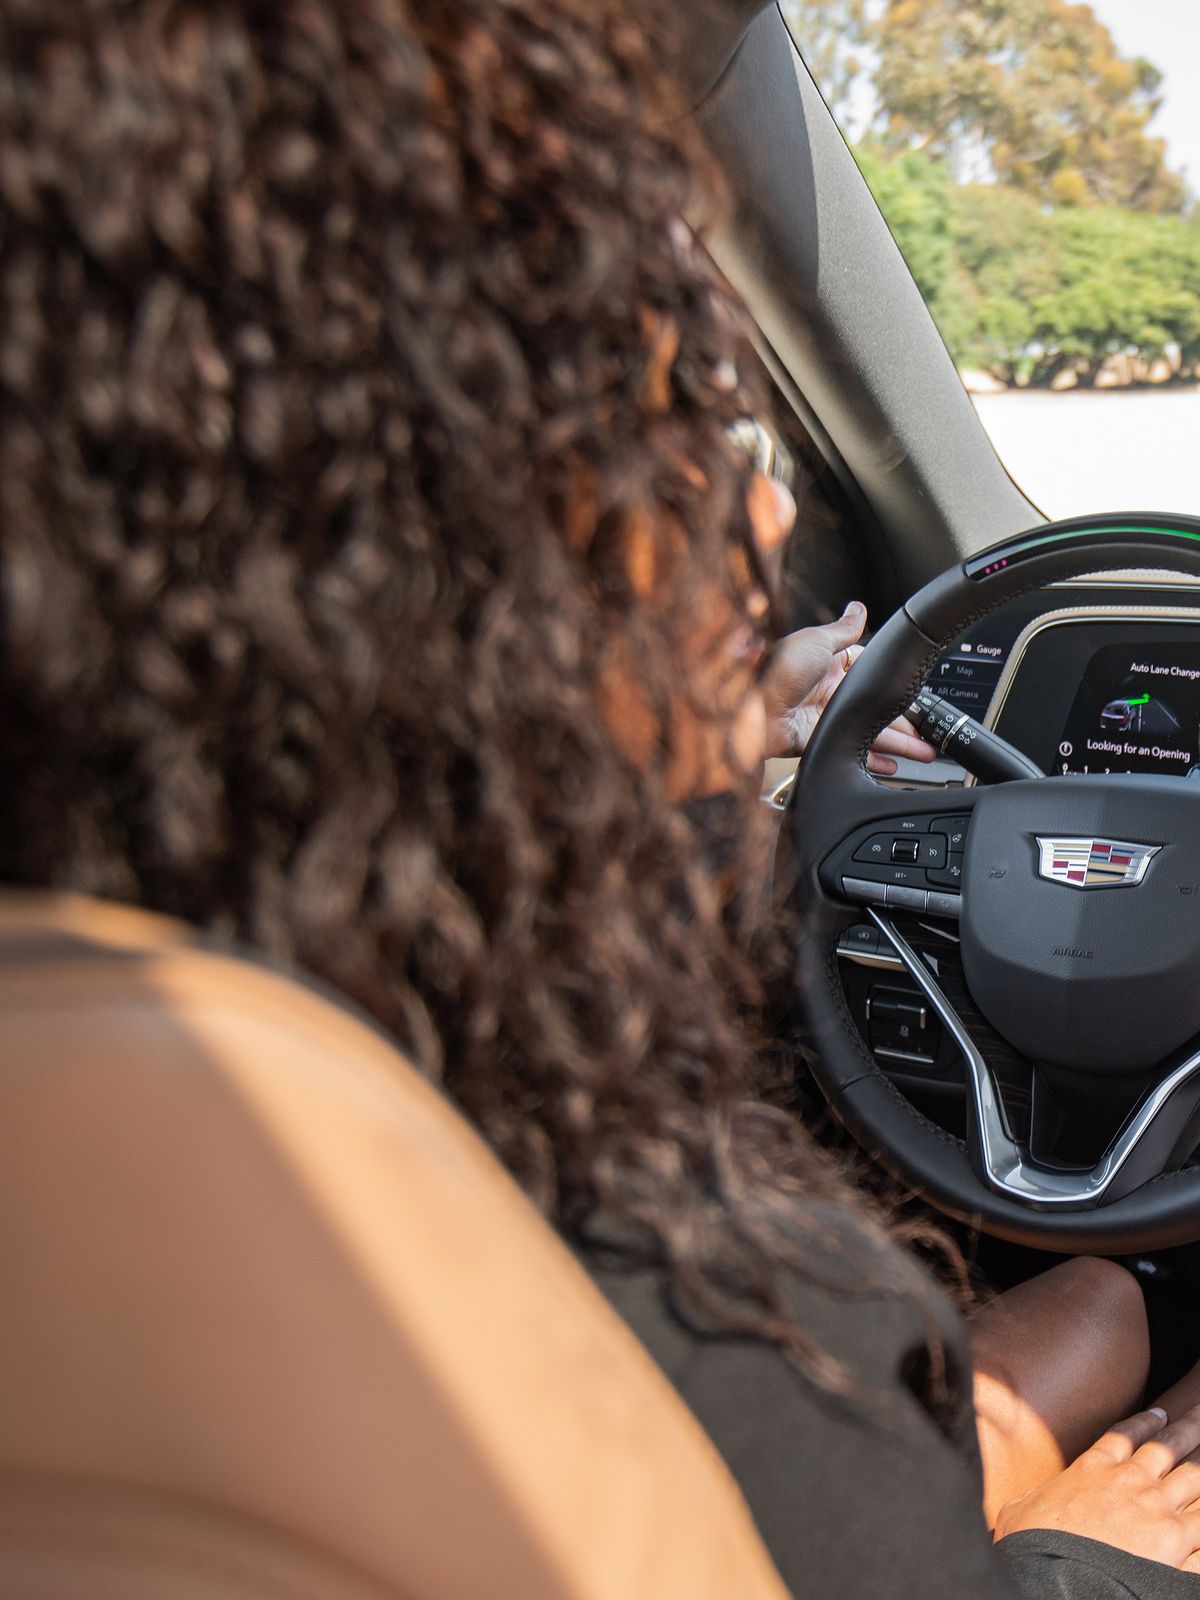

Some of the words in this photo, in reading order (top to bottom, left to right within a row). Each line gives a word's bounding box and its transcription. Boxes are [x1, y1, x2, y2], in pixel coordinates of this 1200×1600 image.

[977, 644, 1002, 656] Gauge
[956, 666, 974, 677] Map
[1131, 662, 1150, 674] Auto
[1150, 664, 1170, 675] Lane
[1170, 667, 1200, 680] Change
[950, 688, 978, 699] Camera
[1087, 738, 1122, 755] Looking
[1124, 742, 1138, 754] for
[1138, 746, 1150, 756] an
[1152, 746, 1191, 763] Opening
[1052, 948, 1094, 960] AIRBAG
